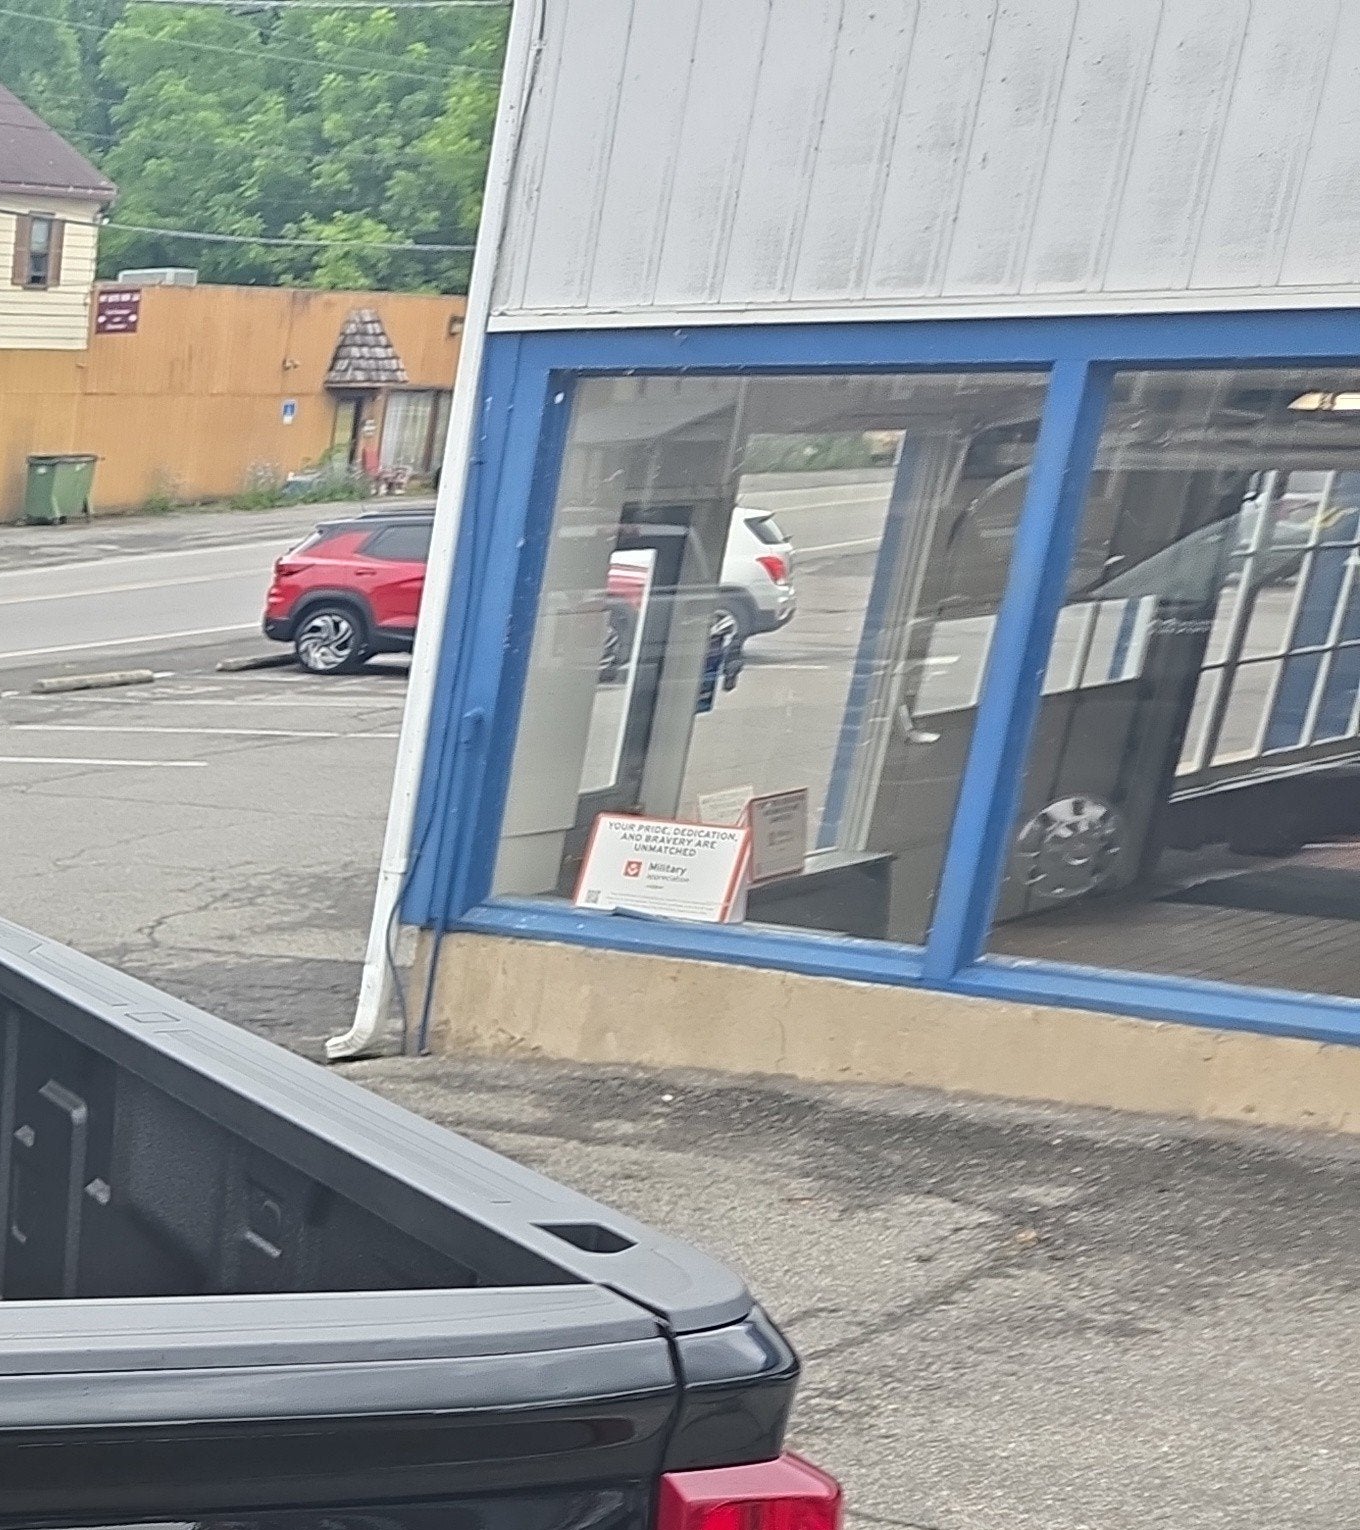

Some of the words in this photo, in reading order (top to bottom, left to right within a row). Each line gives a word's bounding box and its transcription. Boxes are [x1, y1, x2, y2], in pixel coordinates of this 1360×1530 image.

[608, 821, 636, 831] YOUR
[673, 827, 738, 842] DEDICATION,
[620, 832, 643, 842] AND
[644, 834, 693, 847] BRAVERY
[695, 839, 717, 849] ARE
[634, 843, 697, 857] UNMATCHED
[648, 862, 687, 876] Military
